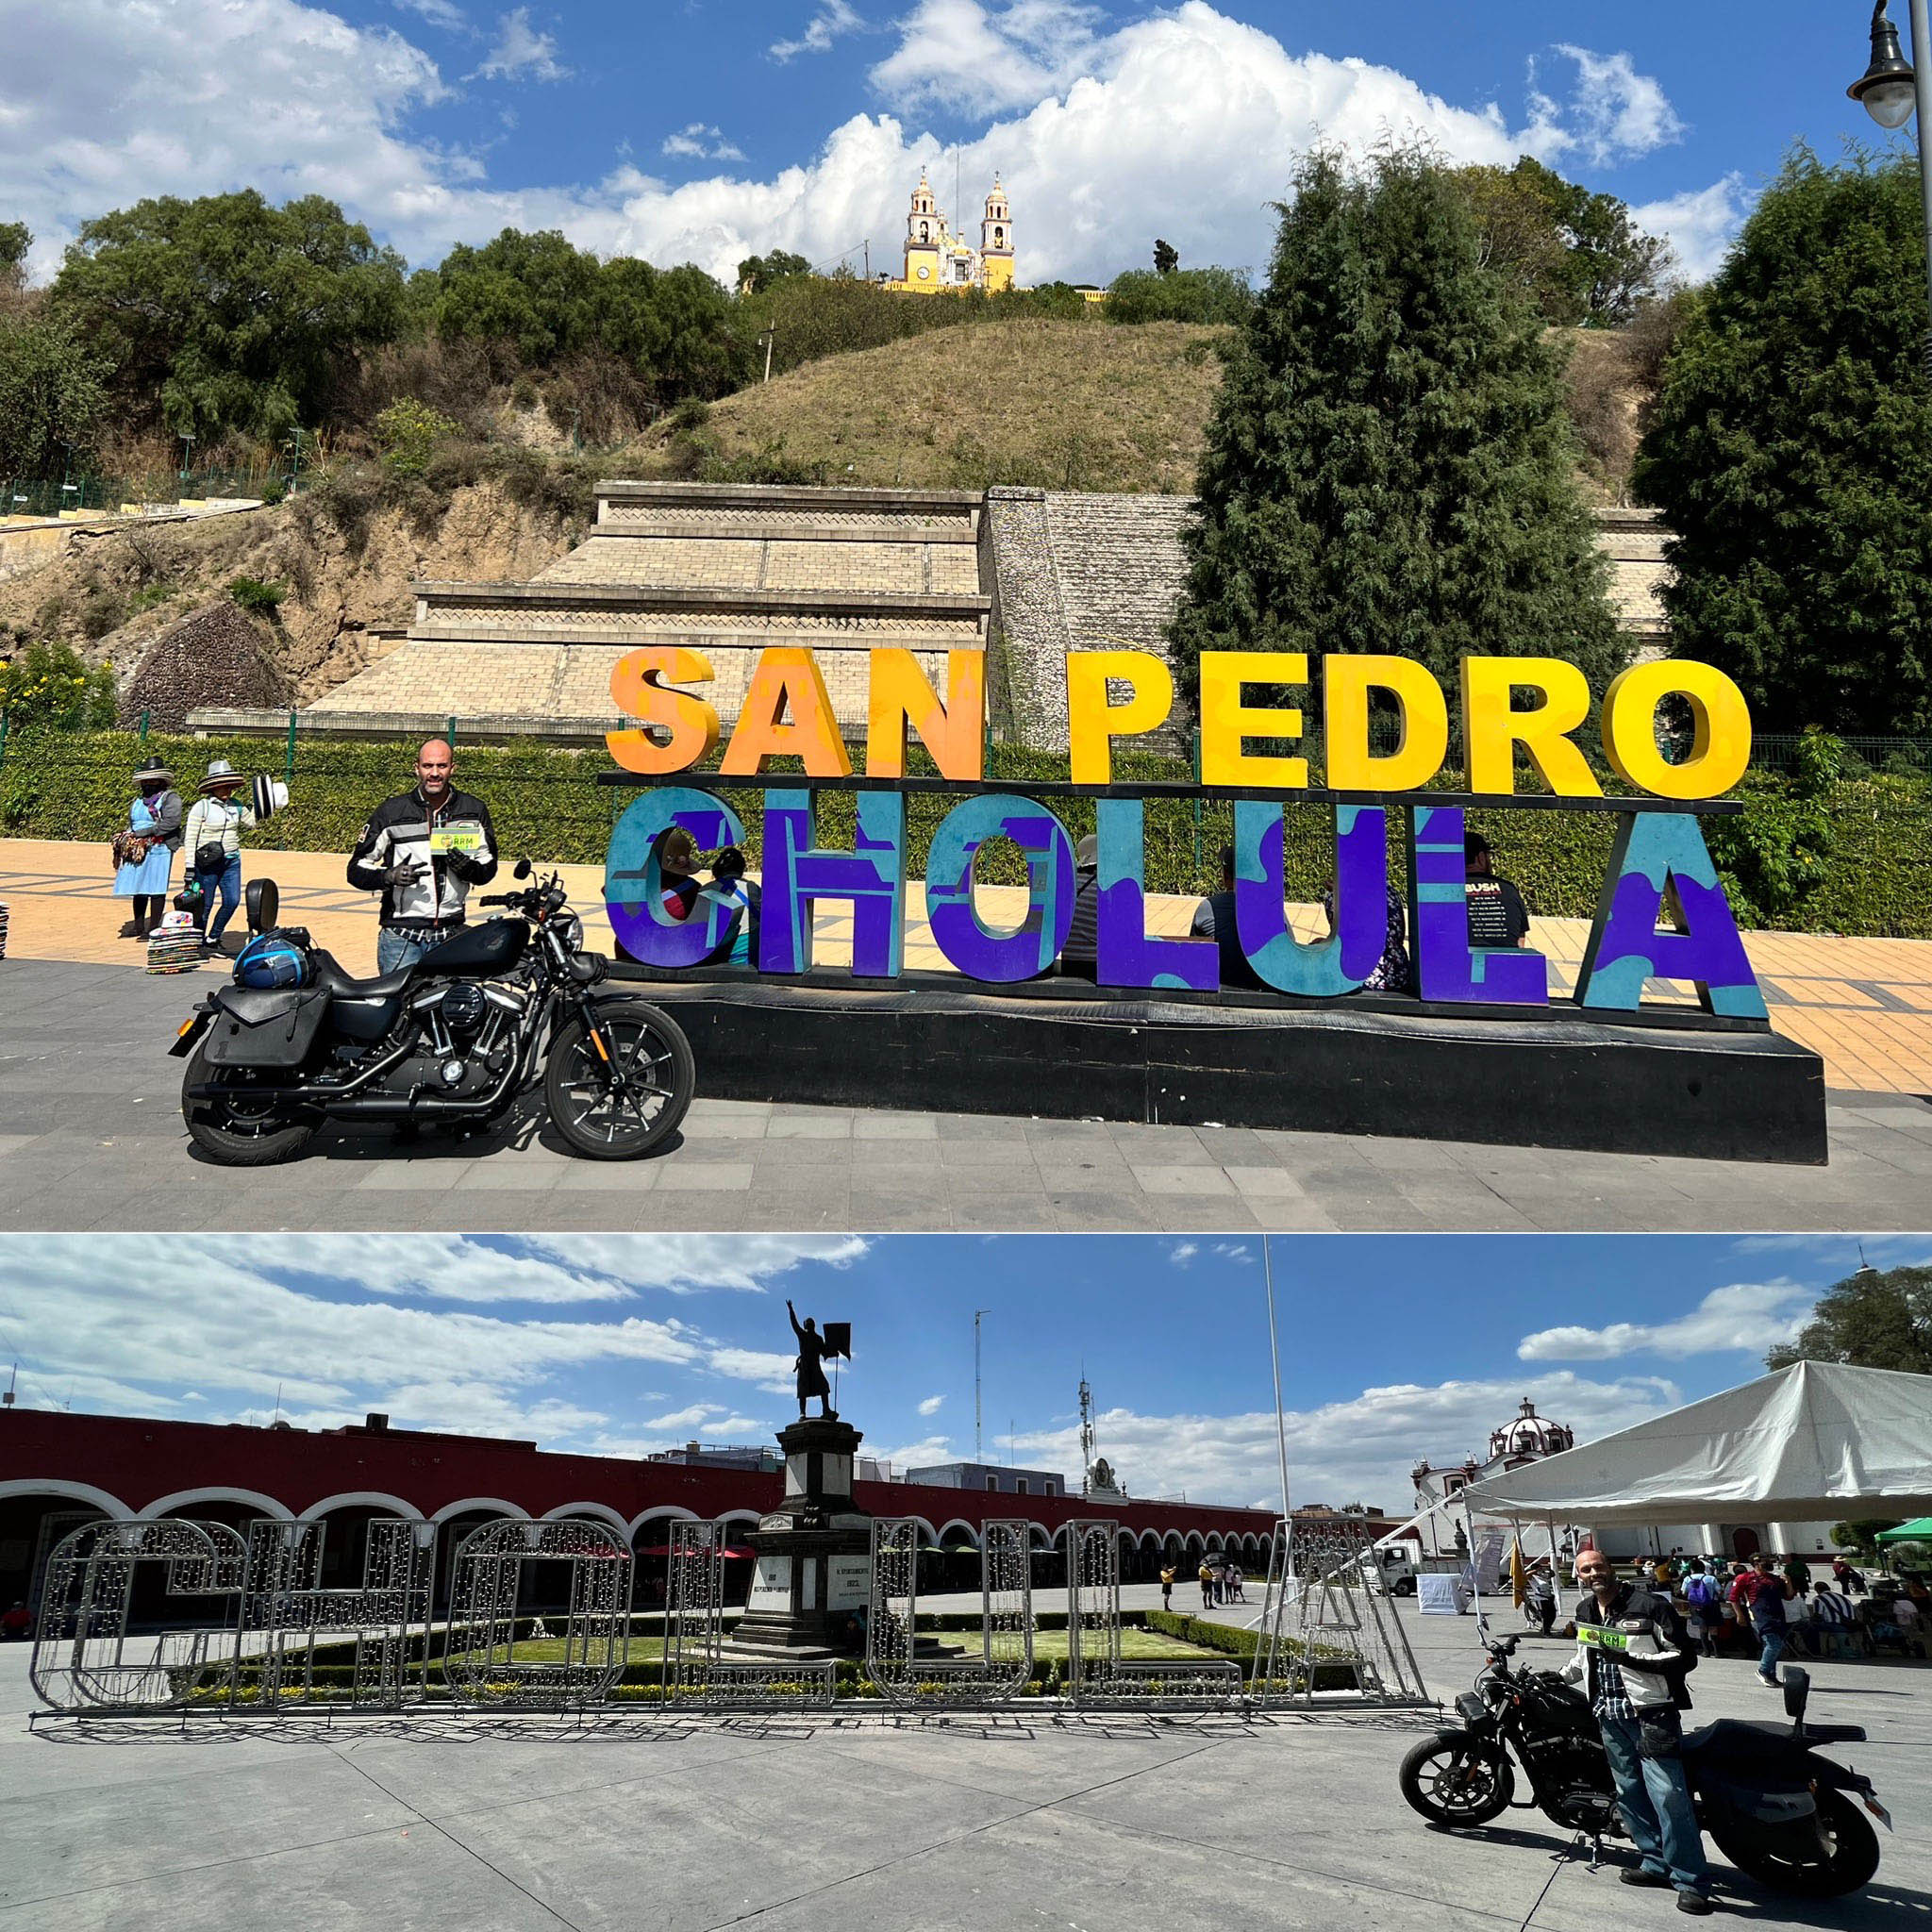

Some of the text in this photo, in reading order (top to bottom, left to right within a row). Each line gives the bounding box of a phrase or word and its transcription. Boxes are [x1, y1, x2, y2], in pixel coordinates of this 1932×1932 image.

[605, 645, 1752, 800] SAN PEDRO
[605, 787, 1769, 1019] CHOLULA
[1465, 882, 1501, 892] BUSH
[29, 1517, 1429, 1709] CHOLULA
